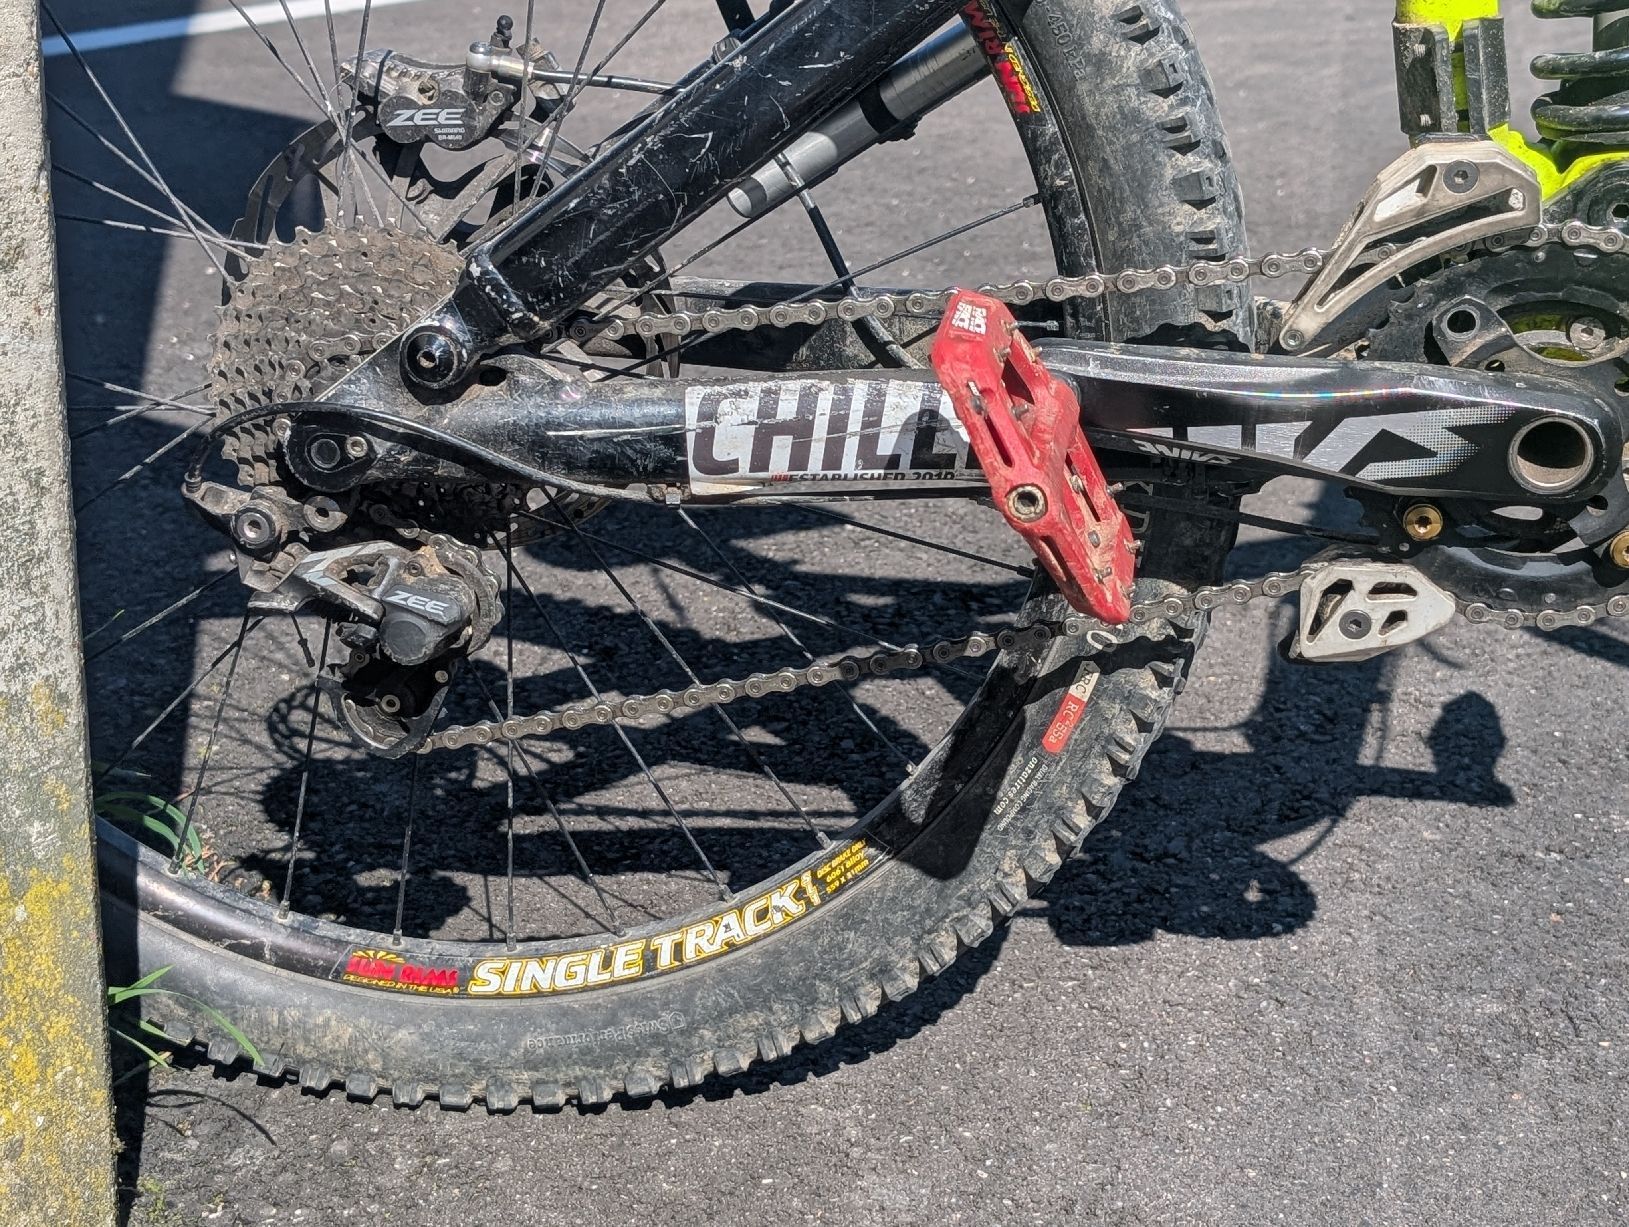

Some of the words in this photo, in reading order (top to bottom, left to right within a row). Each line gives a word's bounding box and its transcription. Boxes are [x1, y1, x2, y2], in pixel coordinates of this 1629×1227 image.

[386, 108, 466, 127] ZEE
[692, 381, 983, 475] CHILL
[385, 590, 450, 614] ZEE
[468, 940, 647, 995] SINGLE
[651, 879, 806, 970] TRACK
[343, 974, 396, 988] DESIGNED
[409, 984, 430, 993] THE
[399, 964, 459, 987] RIMS
